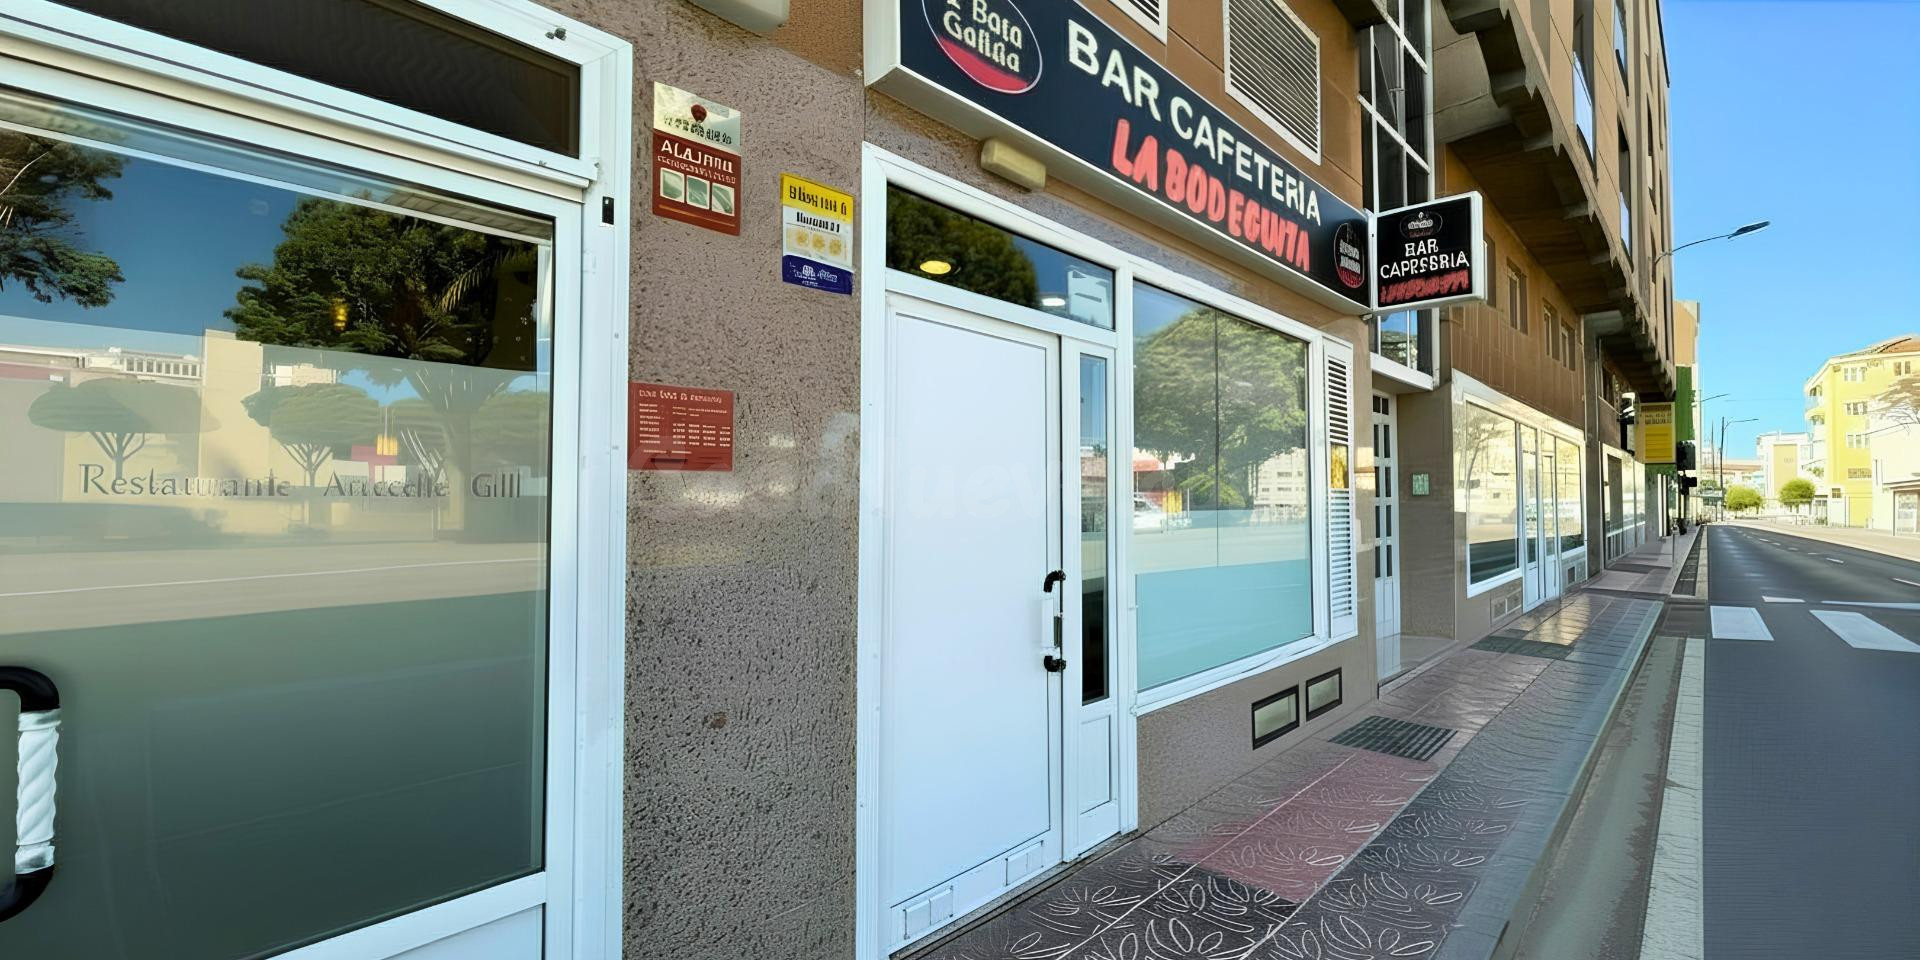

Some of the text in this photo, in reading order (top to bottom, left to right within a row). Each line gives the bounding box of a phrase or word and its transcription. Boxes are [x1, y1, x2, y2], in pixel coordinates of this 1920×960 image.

[1068, 19, 1321, 226] BAR CAFETERIA
[1112, 118, 1158, 192] LA
[1405, 238, 1439, 257] BAR
